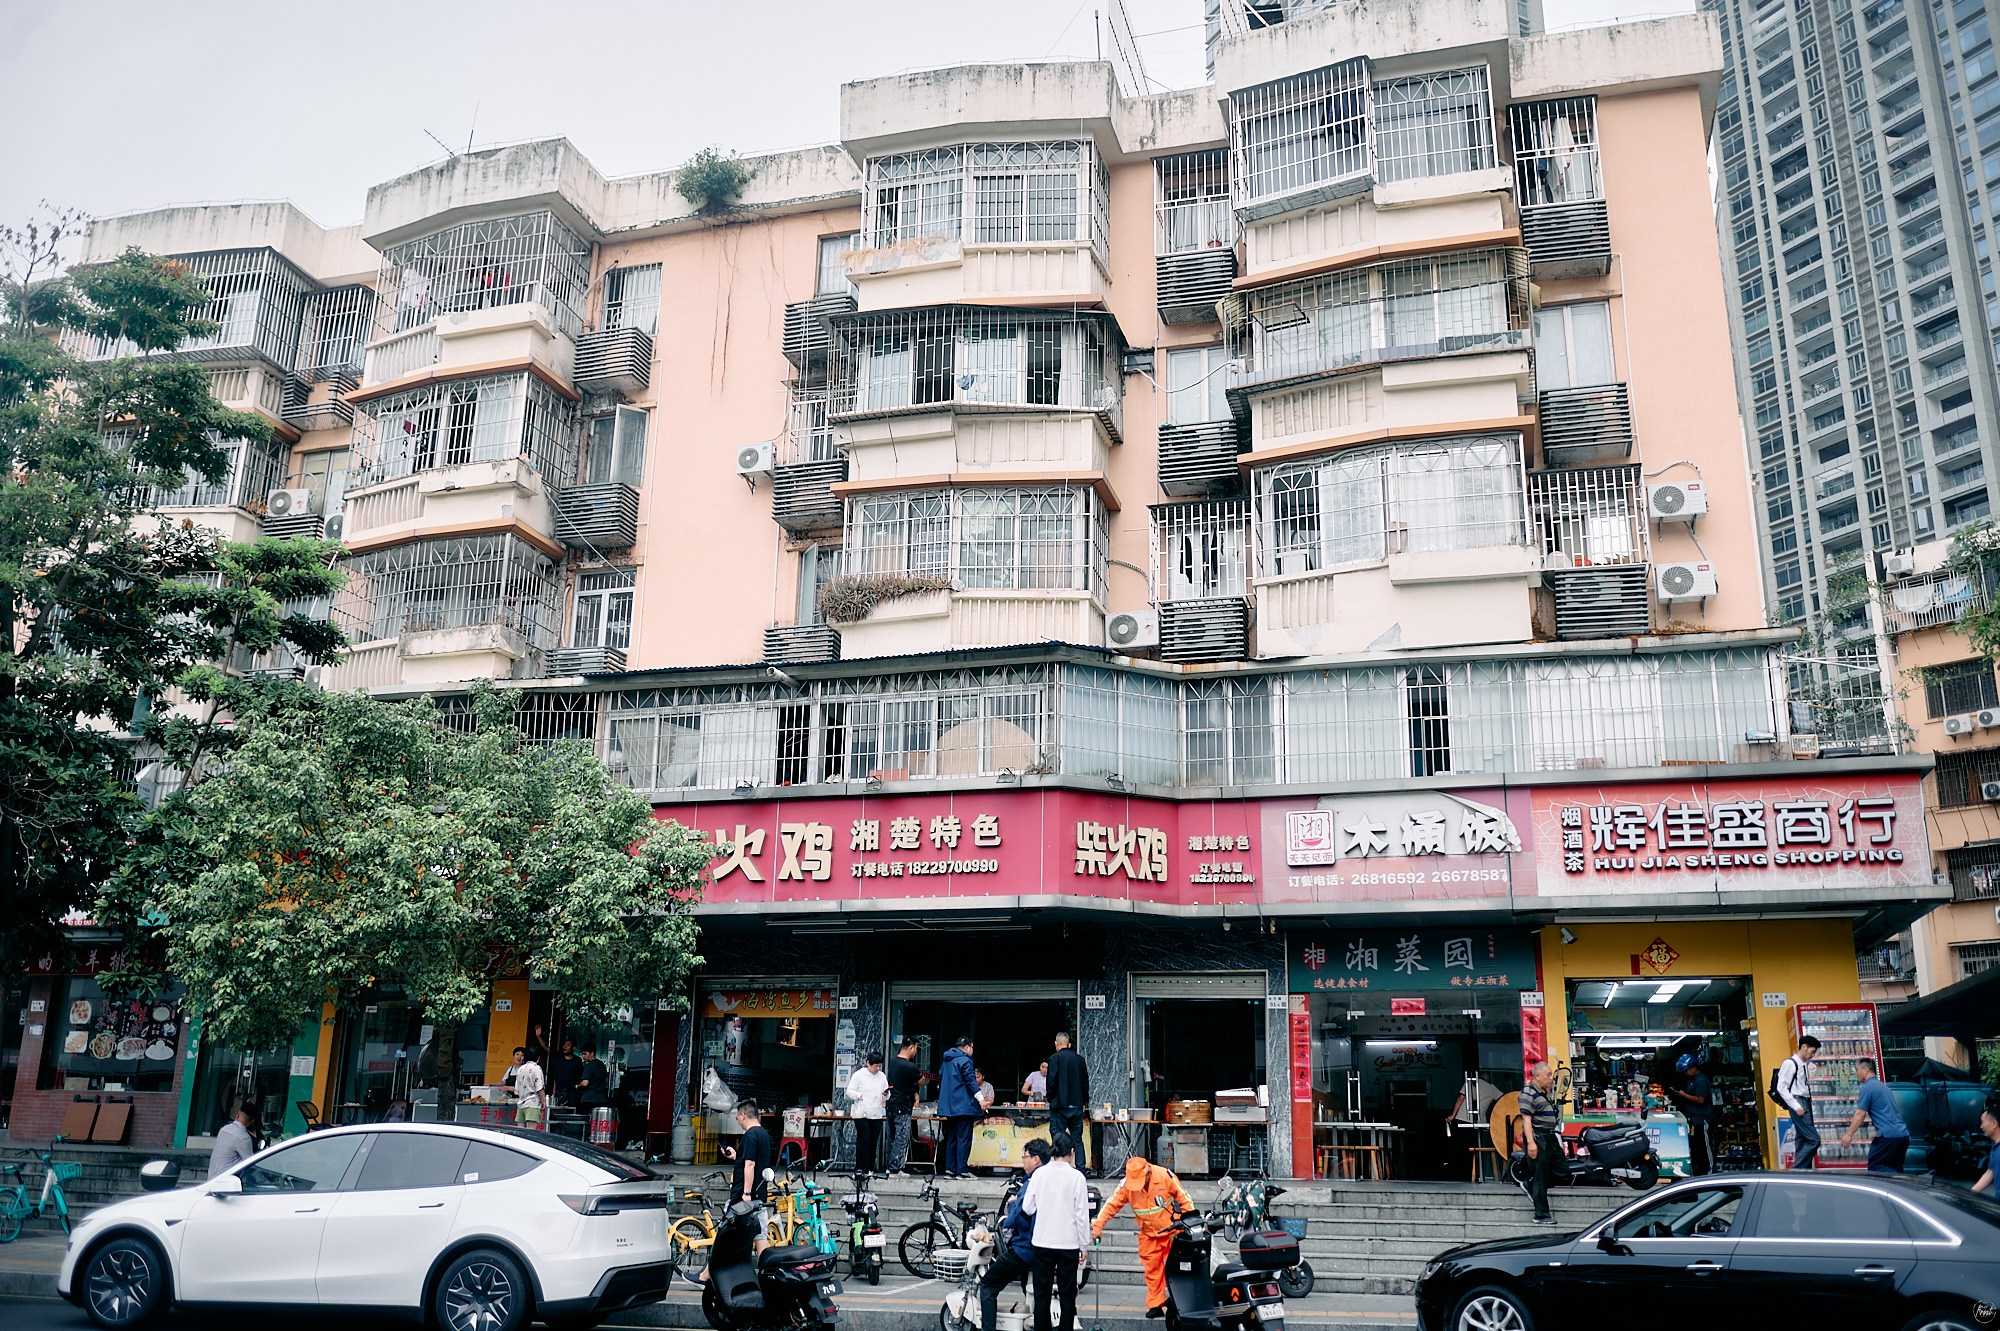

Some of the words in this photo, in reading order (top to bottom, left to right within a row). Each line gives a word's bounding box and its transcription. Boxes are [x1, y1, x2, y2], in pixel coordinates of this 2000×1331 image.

[850, 814, 1001, 851] 湘楚特色
[1344, 809, 1508, 857] 木桶饭
[1562, 807, 1584, 872] 烟酒茶
[1590, 798, 1896, 851] 辉佳盛商行
[684, 822, 833, 881] 火鸡
[1075, 821, 1168, 882] 柴火鸡
[1188, 835, 1250, 851] 湘楚特色
[1289, 852, 1333, 863] 天天见面
[1595, 857, 1634, 870] HUI
[1641, 854, 1681, 869] JIA
[1685, 852, 1768, 867] SHENG
[1774, 848, 1903, 864] SHOPPING
[850, 862, 904, 877] 订餐电话
[907, 858, 999, 876] 18229700990
[1351, 872, 1425, 885] 26816592
[1431, 869, 1508, 883] 26678587
[1304, 942, 1325, 970] 湘
[1345, 934, 1474, 975] 湘菜园
[1650, 943, 1671, 964] 福
